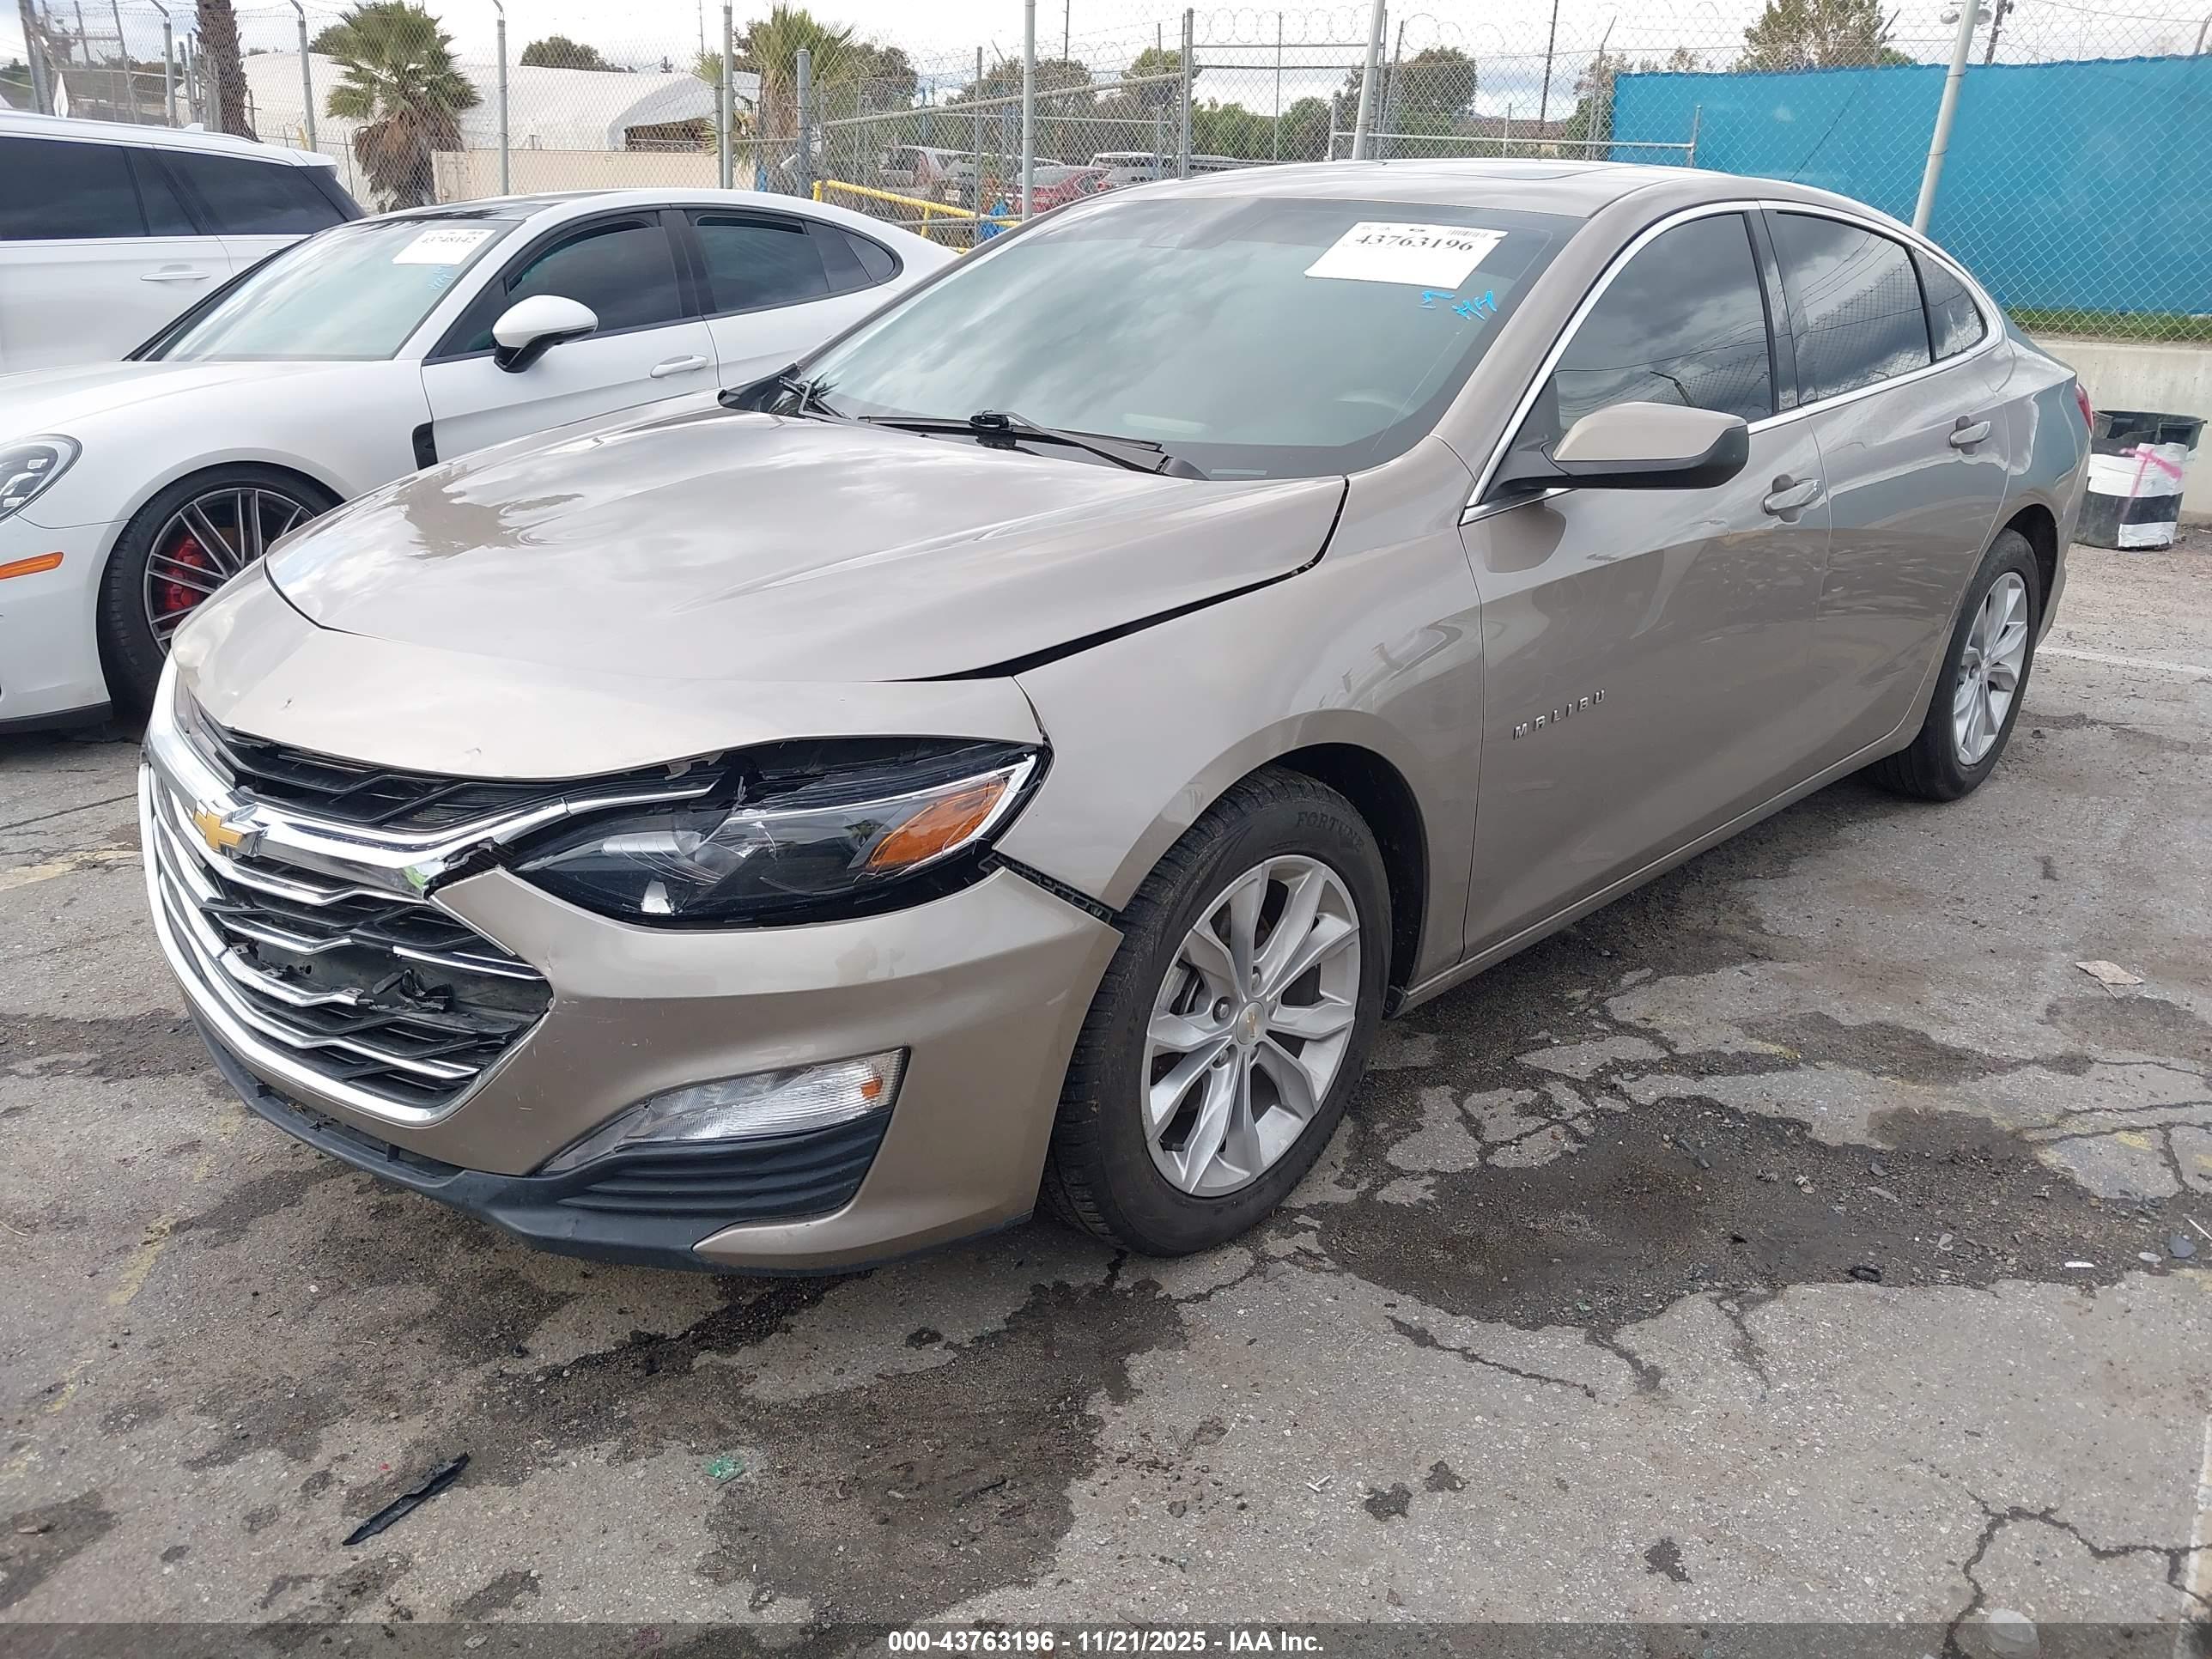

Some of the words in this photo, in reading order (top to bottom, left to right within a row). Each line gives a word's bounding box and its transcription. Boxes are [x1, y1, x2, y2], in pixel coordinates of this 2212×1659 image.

[1354, 233, 1477, 252] 43763196
[1513, 689, 1606, 740] MALIBU
[1296, 810, 1365, 853] FORTUNE
